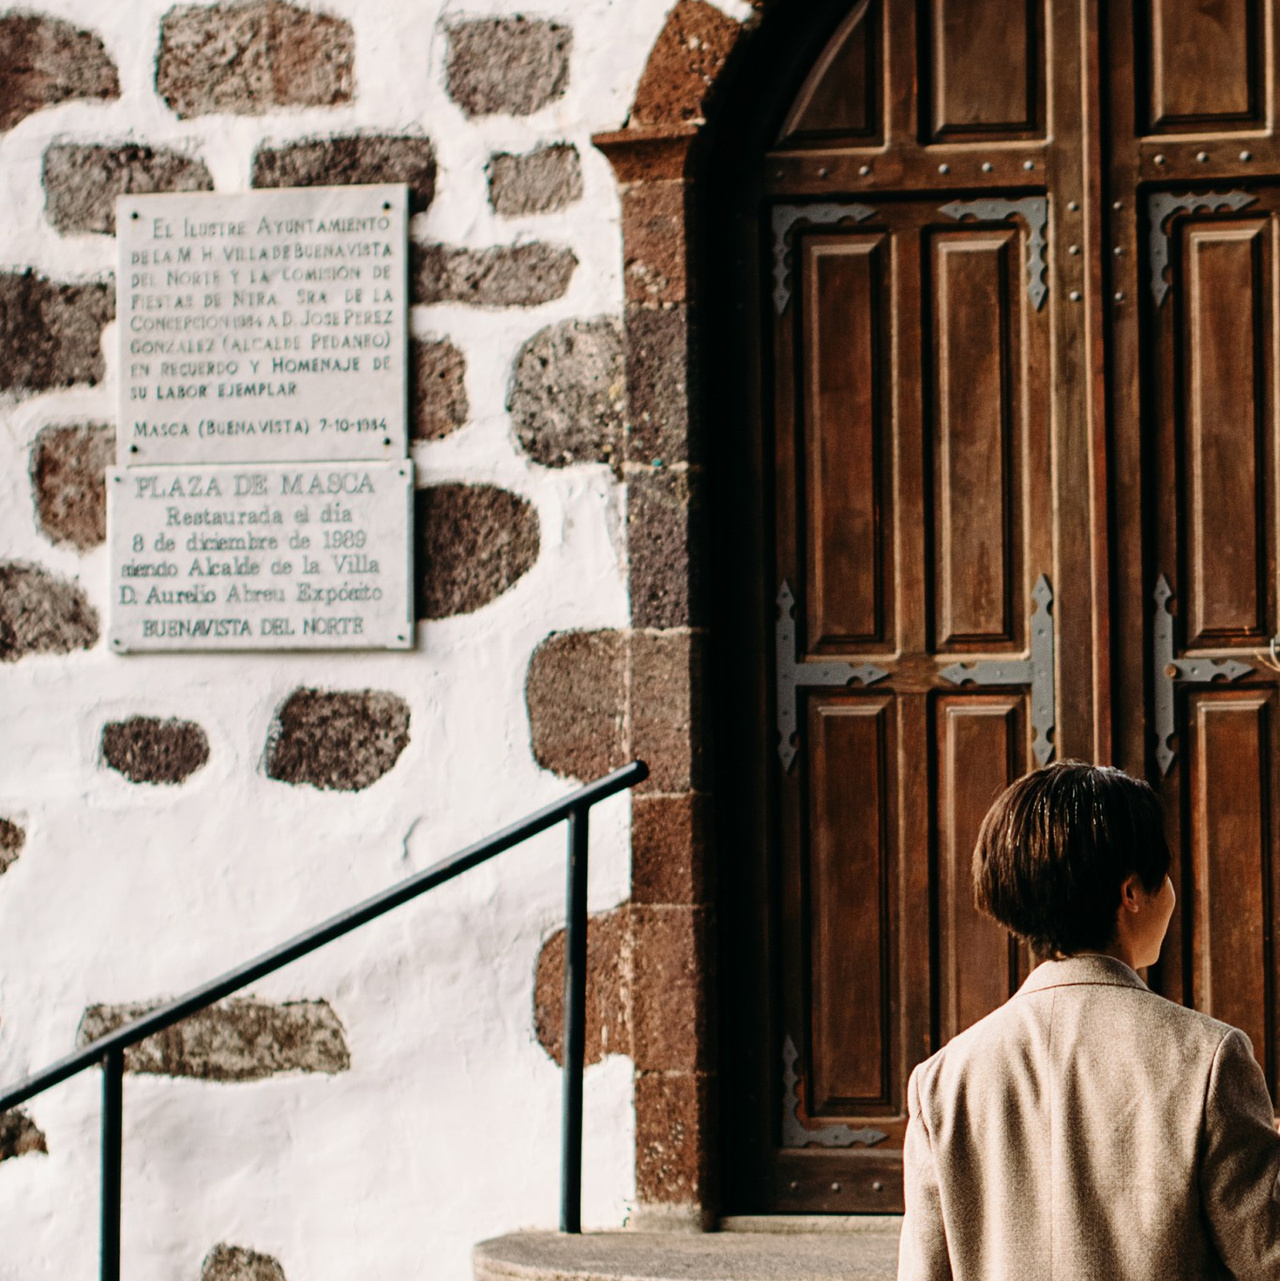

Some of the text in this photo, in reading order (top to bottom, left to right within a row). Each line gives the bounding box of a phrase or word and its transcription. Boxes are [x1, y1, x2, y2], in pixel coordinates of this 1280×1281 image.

[153, 217, 390, 238] EL ILUSTRE AYUNTAMIENTO
[223, 246, 267, 262] VILLA
[294, 242, 392, 258] BUENAVISTA
[167, 270, 220, 286] NORTE
[231, 270, 239, 284] Y
[250, 269, 269, 282] LA
[373, 265, 391, 279] DE
[132, 294, 192, 310] FIESTAS
[204, 294, 221, 308] DE
[345, 288, 362, 302] DE
[374, 289, 393, 302] LA
[131, 356, 390, 377] EN RECUERDO Y HOMENAJE DE
[131, 382, 296, 400] SU LABOR EJEMPLAR
[134, 418, 386, 438] MASCA (BUENAVISTA) 7-10-1984
[135, 473, 375, 498] PLAZA DE MASCA
[166, 502, 352, 524] Restaurada el día
[133, 530, 367, 551] 8 de diciembre de 1989
[122, 555, 379, 578] siendo Alcalde de la Villa
[119, 581, 383, 605] D. Aurelio Abreu Expósito
[143, 618, 363, 638] BUENAVISTA DEL NORTE
